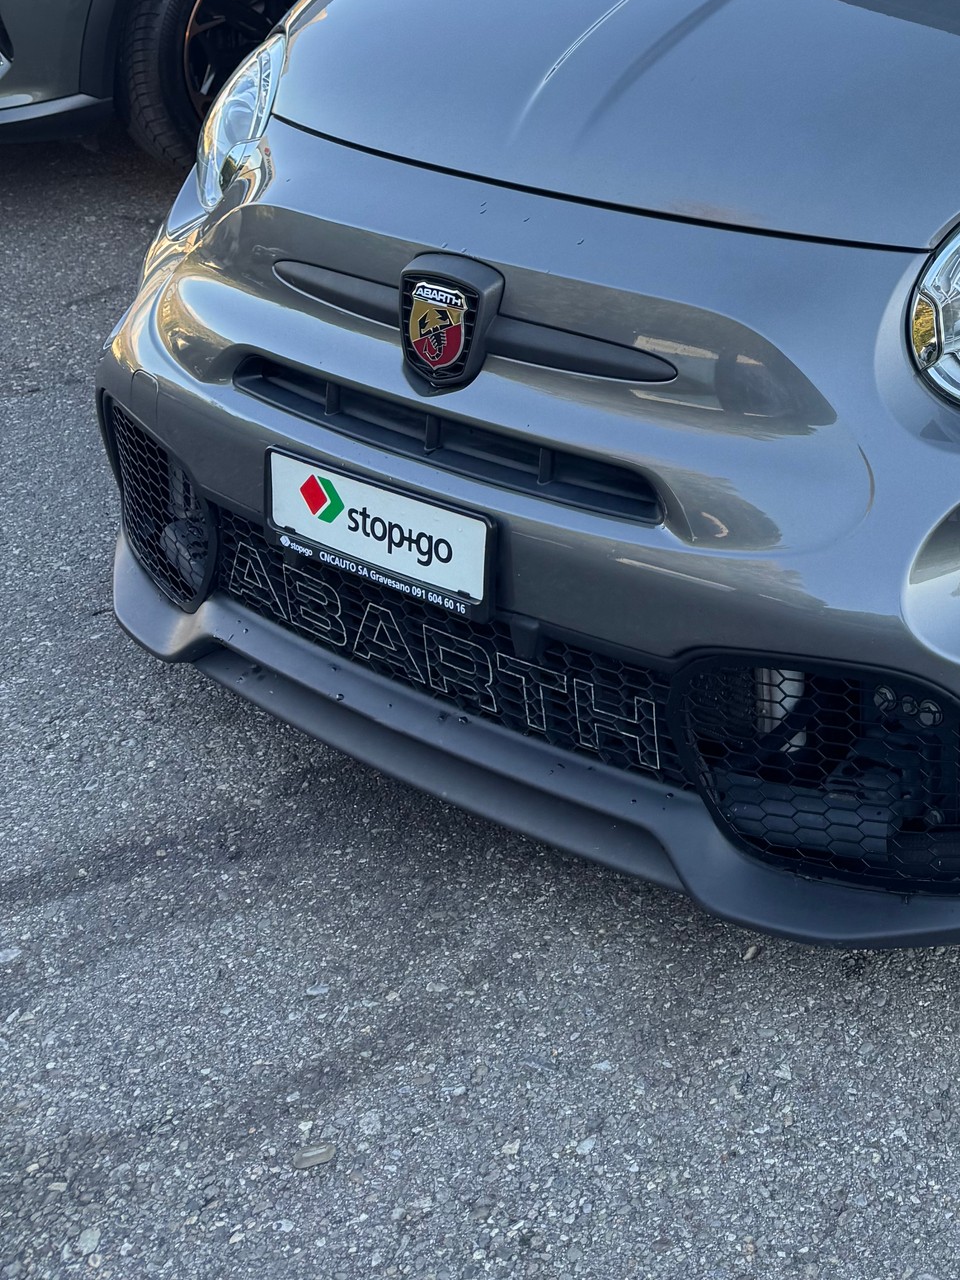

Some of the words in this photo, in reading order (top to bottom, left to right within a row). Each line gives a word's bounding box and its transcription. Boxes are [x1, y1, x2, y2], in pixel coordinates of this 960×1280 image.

[415, 287, 461, 306] ABARTH
[347, 507, 453, 567] stop+go
[319, 551, 357, 573] CNCAUTO
[358, 566, 369, 579] SA
[369, 570, 411, 593] Gravesano
[411, 585, 426, 600] 091
[427, 594, 442, 606] 604
[444, 599, 454, 610] 60
[456, 603, 466, 615] 16
[229, 542, 661, 770] ABARTH
